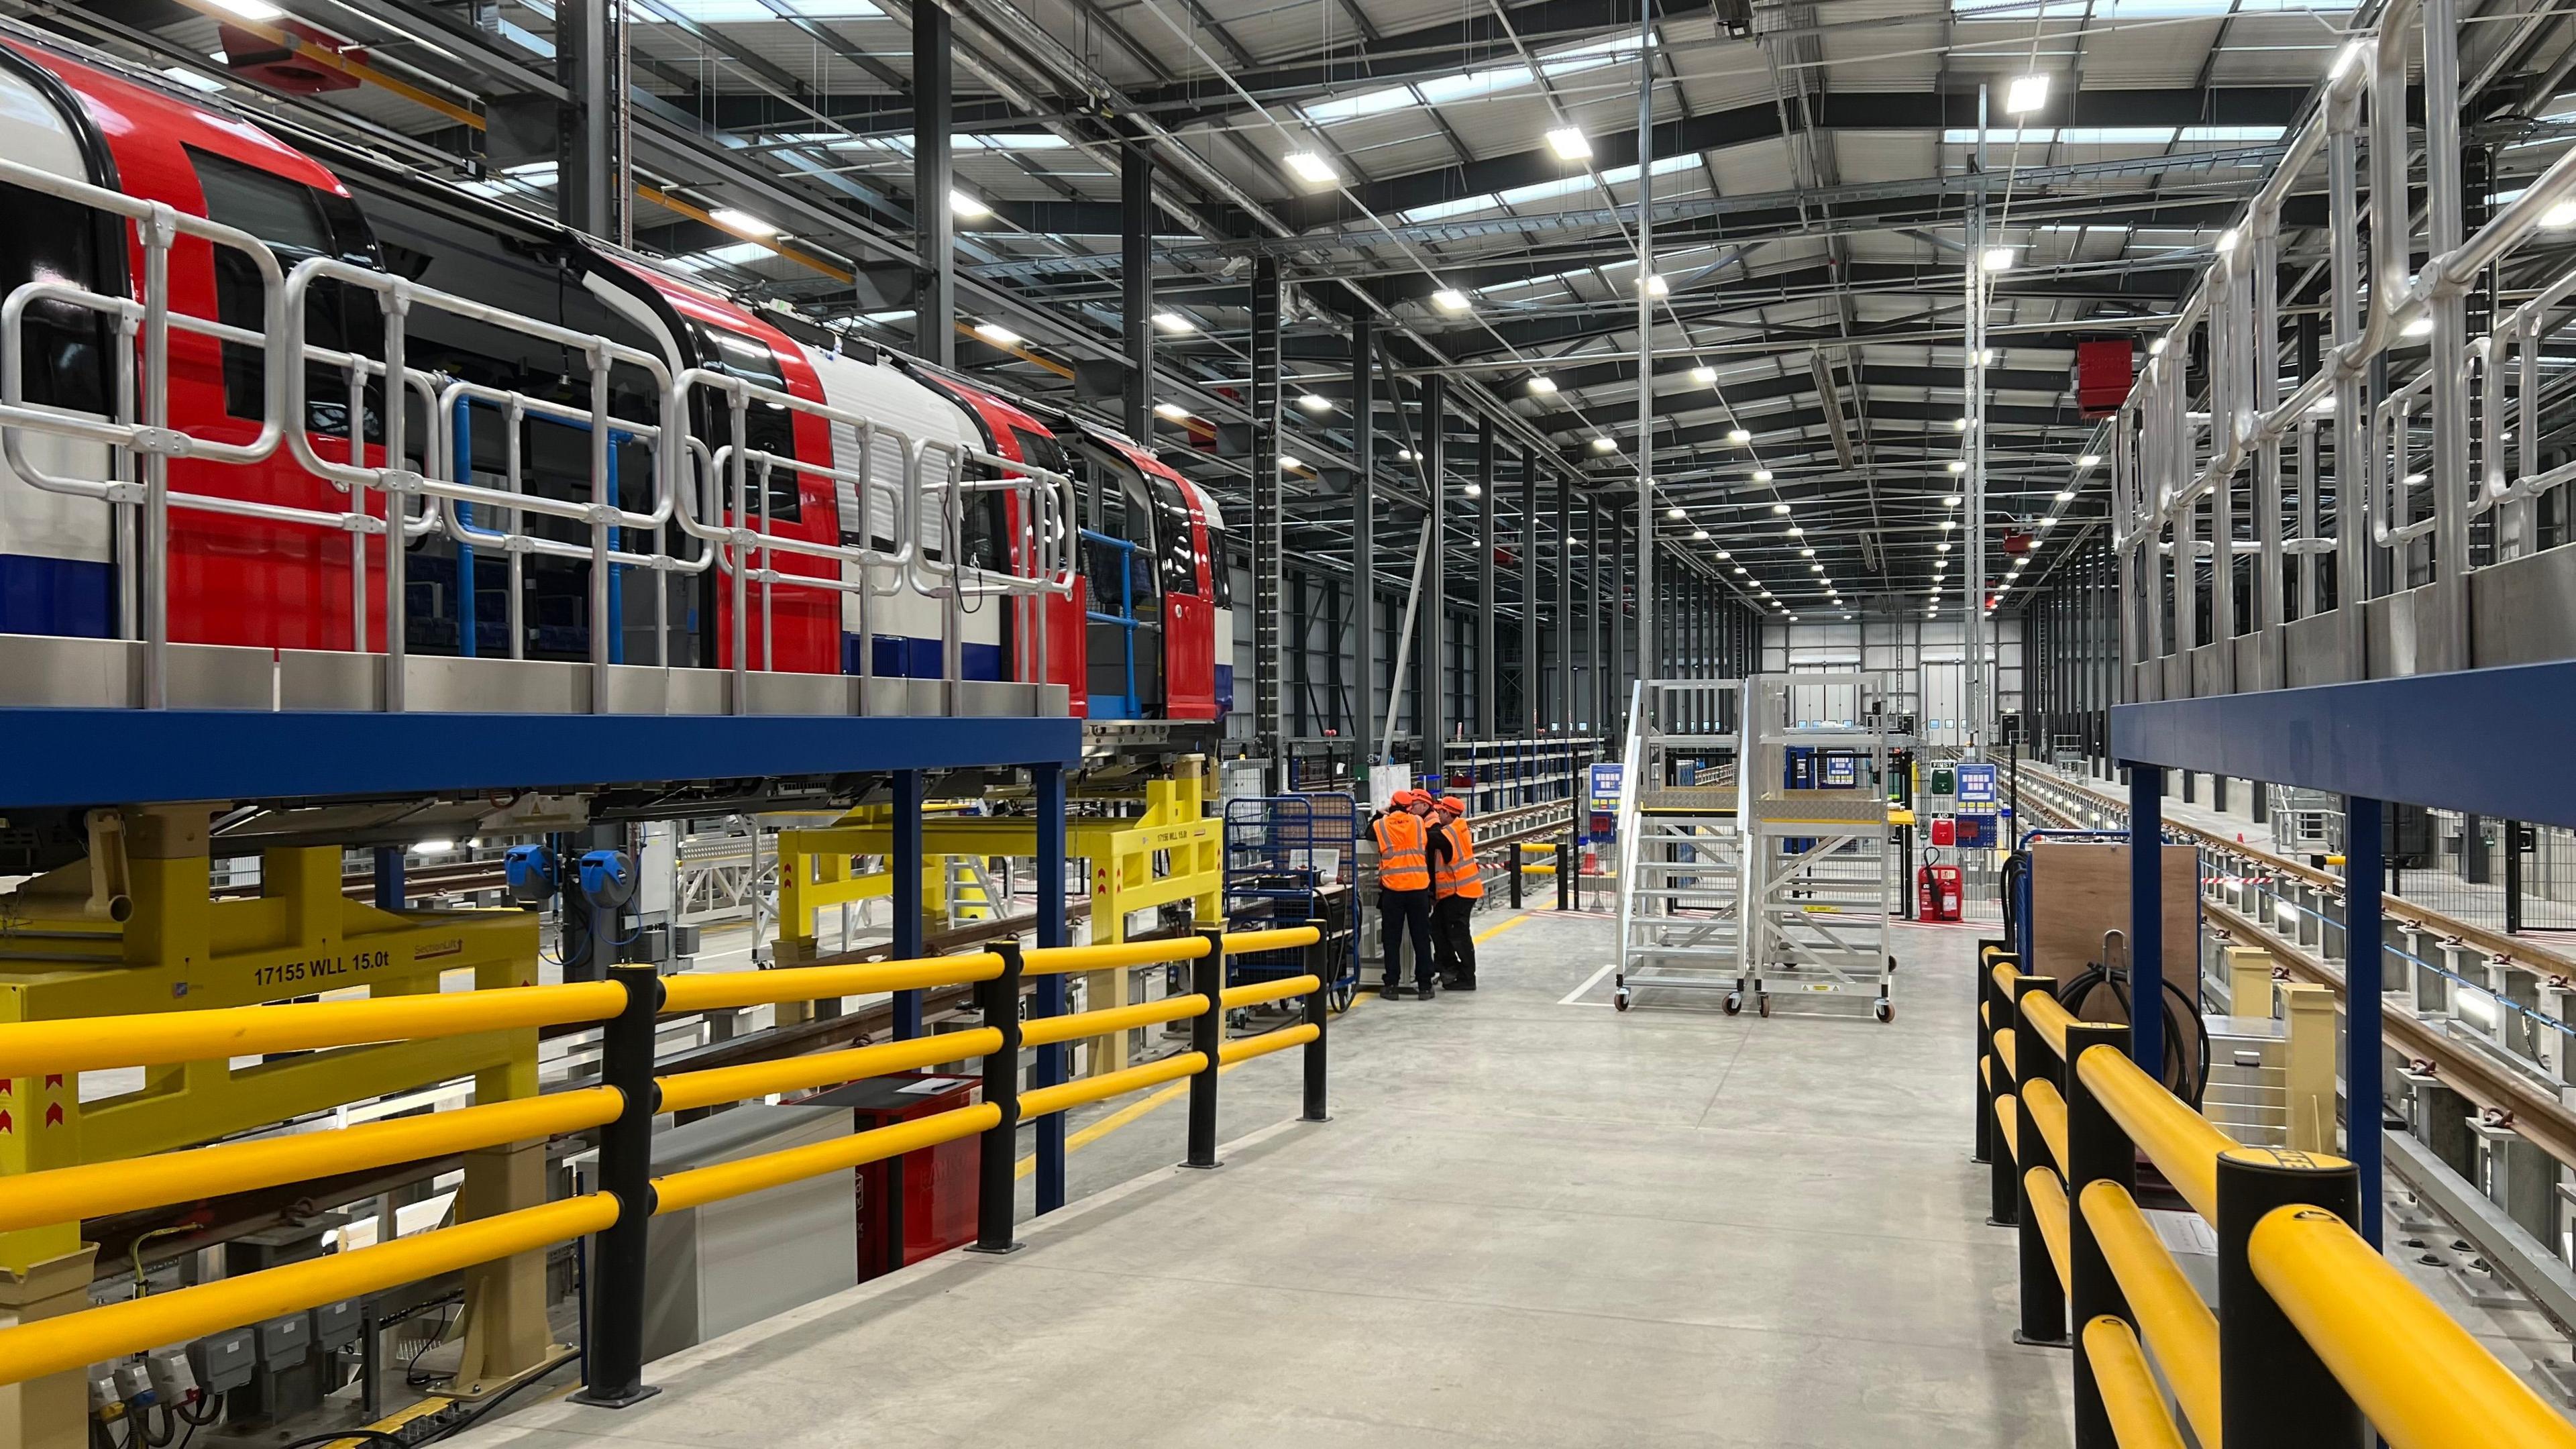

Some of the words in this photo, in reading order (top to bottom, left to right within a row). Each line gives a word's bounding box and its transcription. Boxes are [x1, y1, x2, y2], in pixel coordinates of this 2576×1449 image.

[255, 963, 305, 985] 17155
[310, 957, 347, 977] WLL
[353, 951, 389, 970] 15.0t
